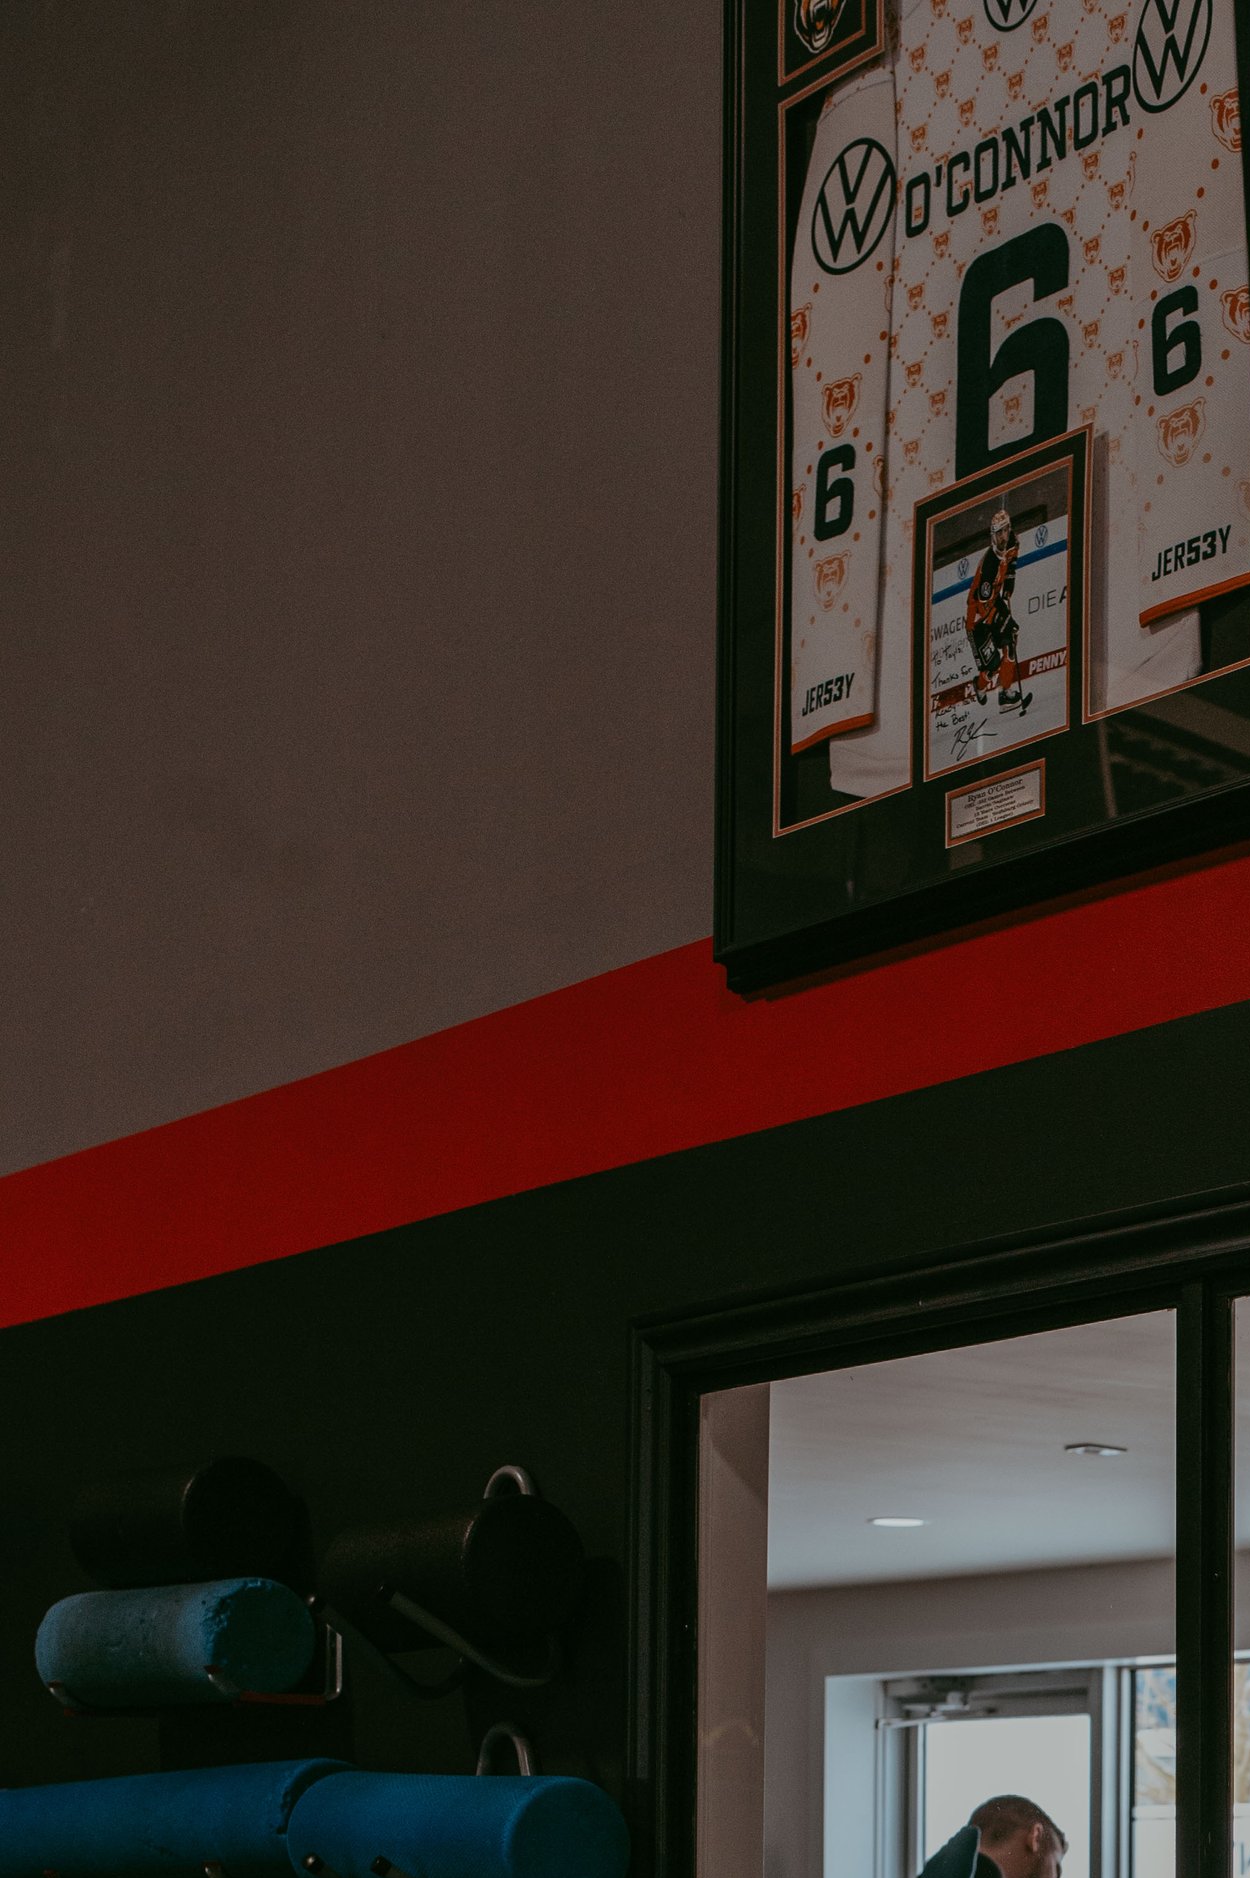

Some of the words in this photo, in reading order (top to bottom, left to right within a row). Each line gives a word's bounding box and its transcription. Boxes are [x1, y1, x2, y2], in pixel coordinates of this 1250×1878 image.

[811, 138, 897, 275] VW
[904, 64, 1132, 239] O'CONNOR
[955, 222, 1070, 481] 6
[1152, 285, 1201, 396] 6
[813, 443, 856, 542] 6
